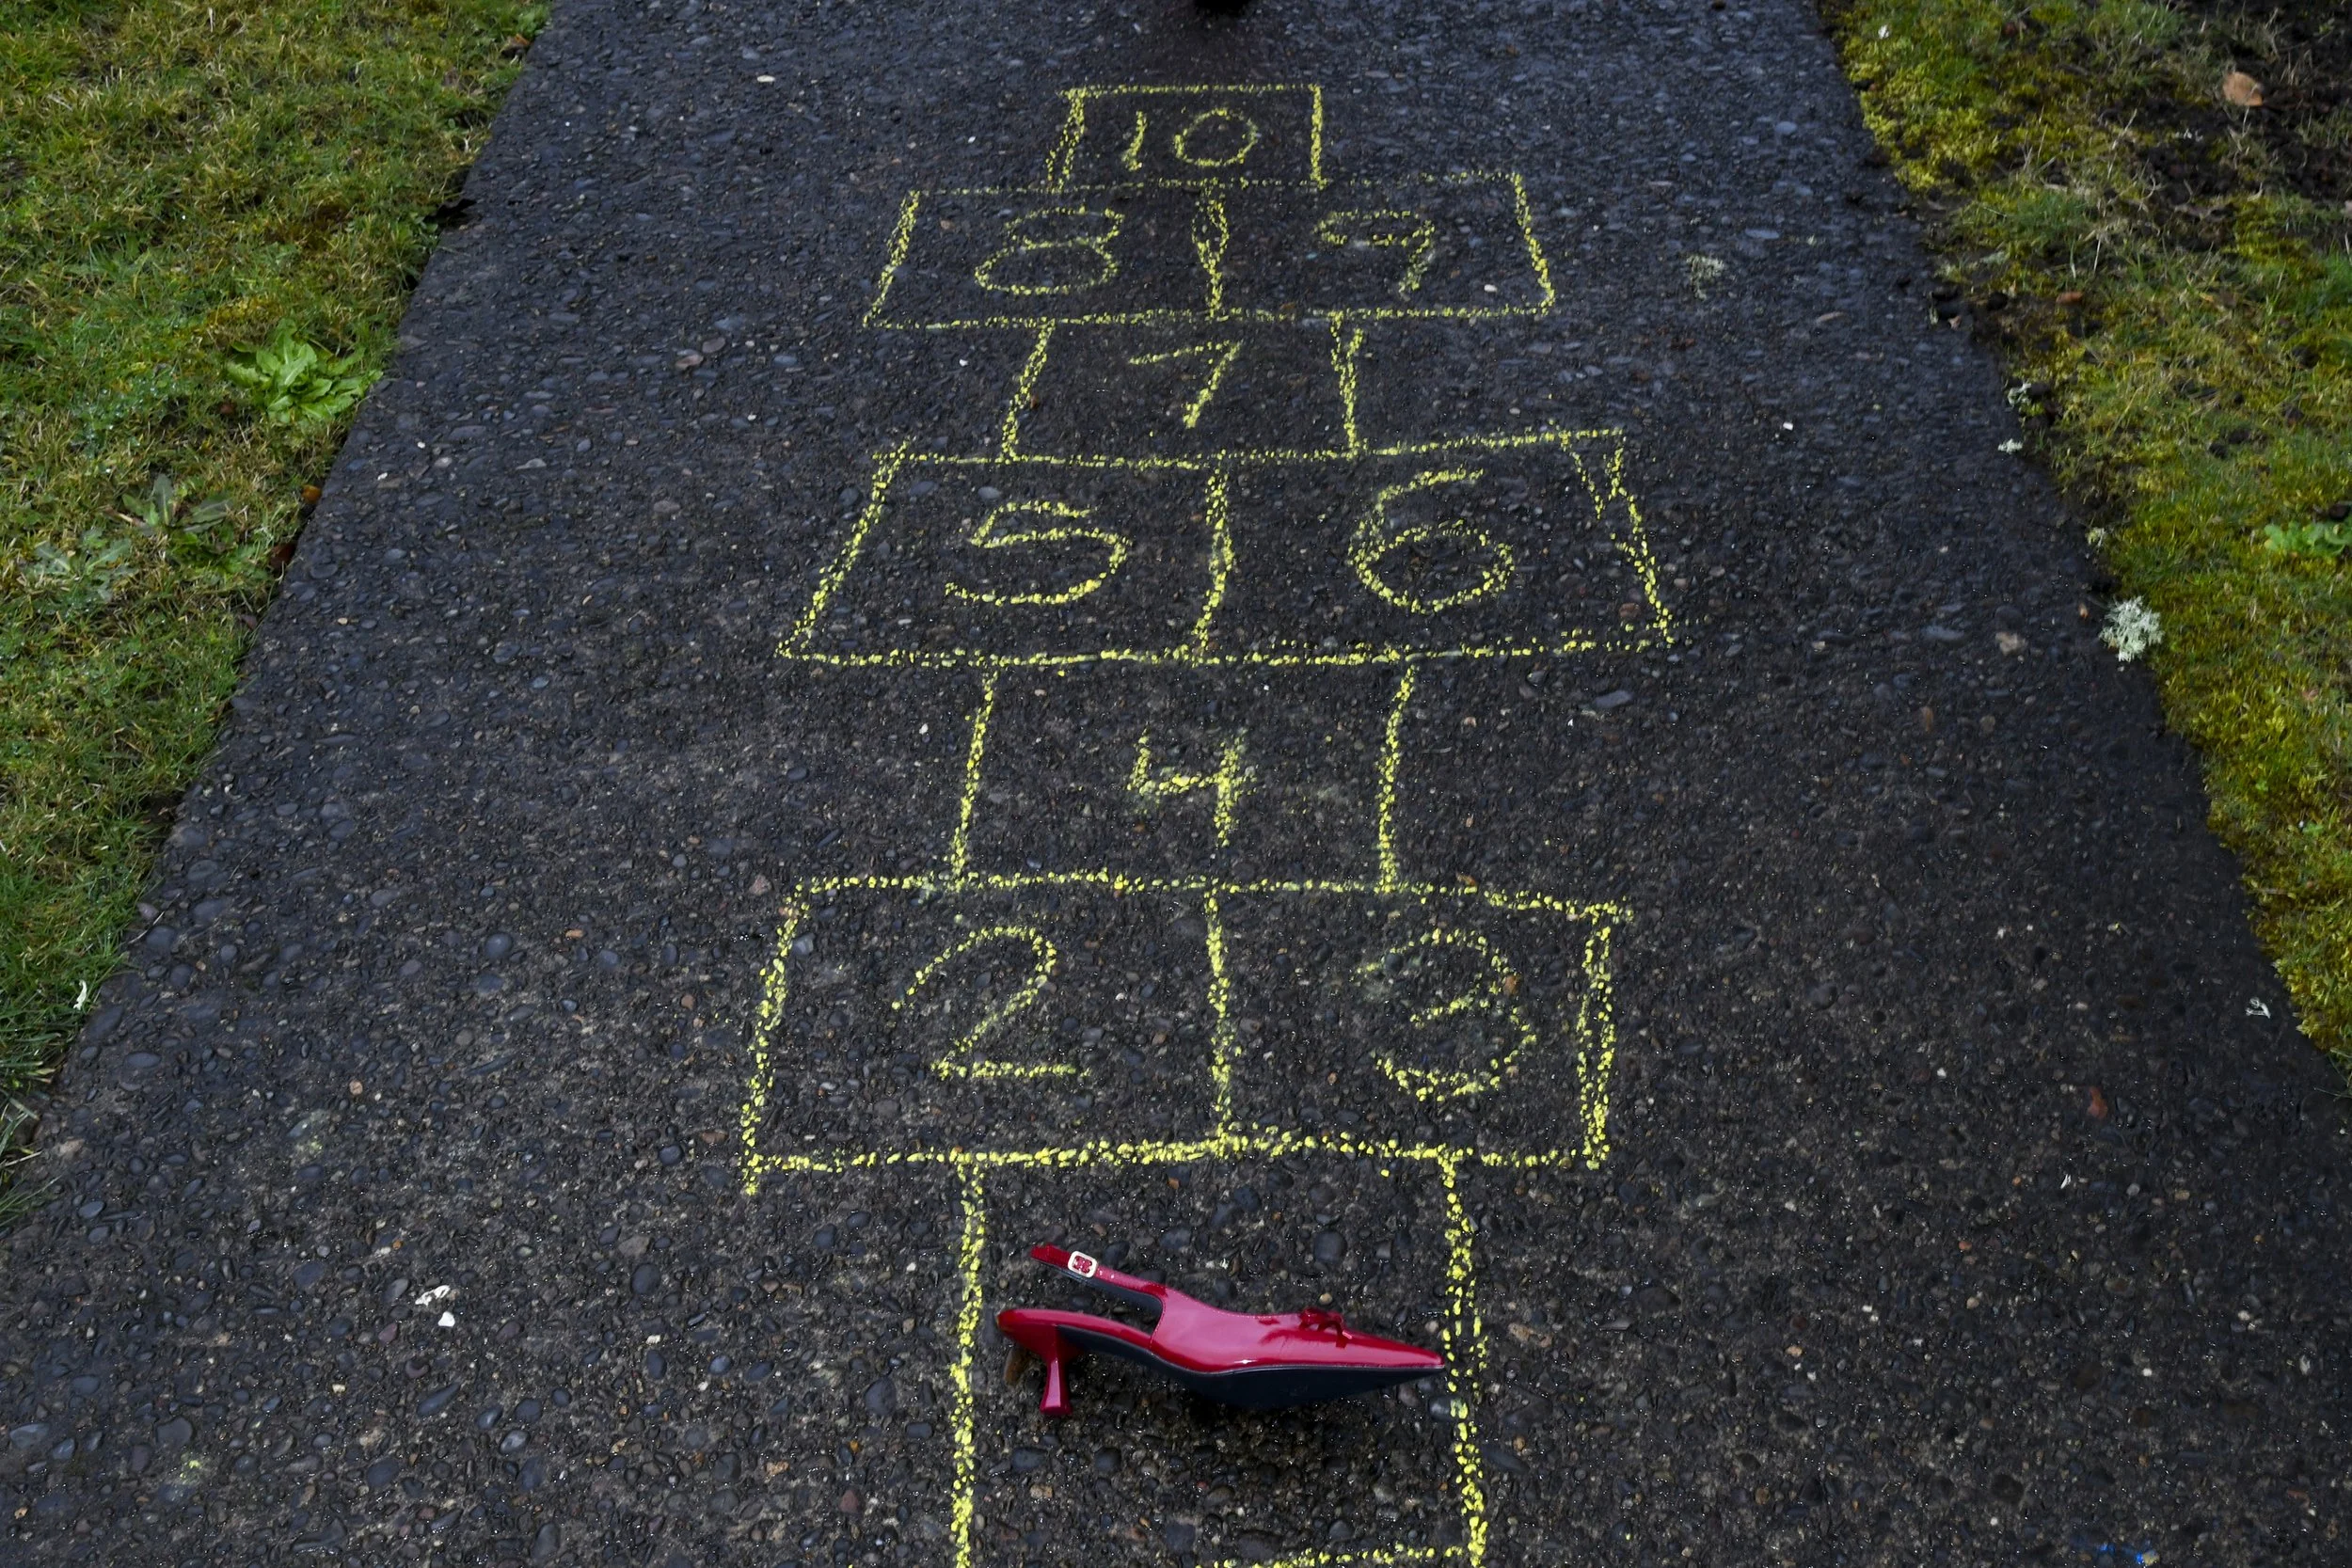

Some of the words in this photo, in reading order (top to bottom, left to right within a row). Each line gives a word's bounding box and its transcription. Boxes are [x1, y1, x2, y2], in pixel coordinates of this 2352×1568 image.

[1122, 108, 1259, 171] 10
[973, 204, 1126, 296] 8
[1317, 209, 1436, 299] 9
[1129, 340, 1243, 429] 7
[944, 499, 1130, 606] 5
[1353, 468, 1513, 613] 6
[1129, 726, 1258, 847] 4
[892, 925, 1089, 1082] 2
[1355, 929, 1537, 1102] 3
